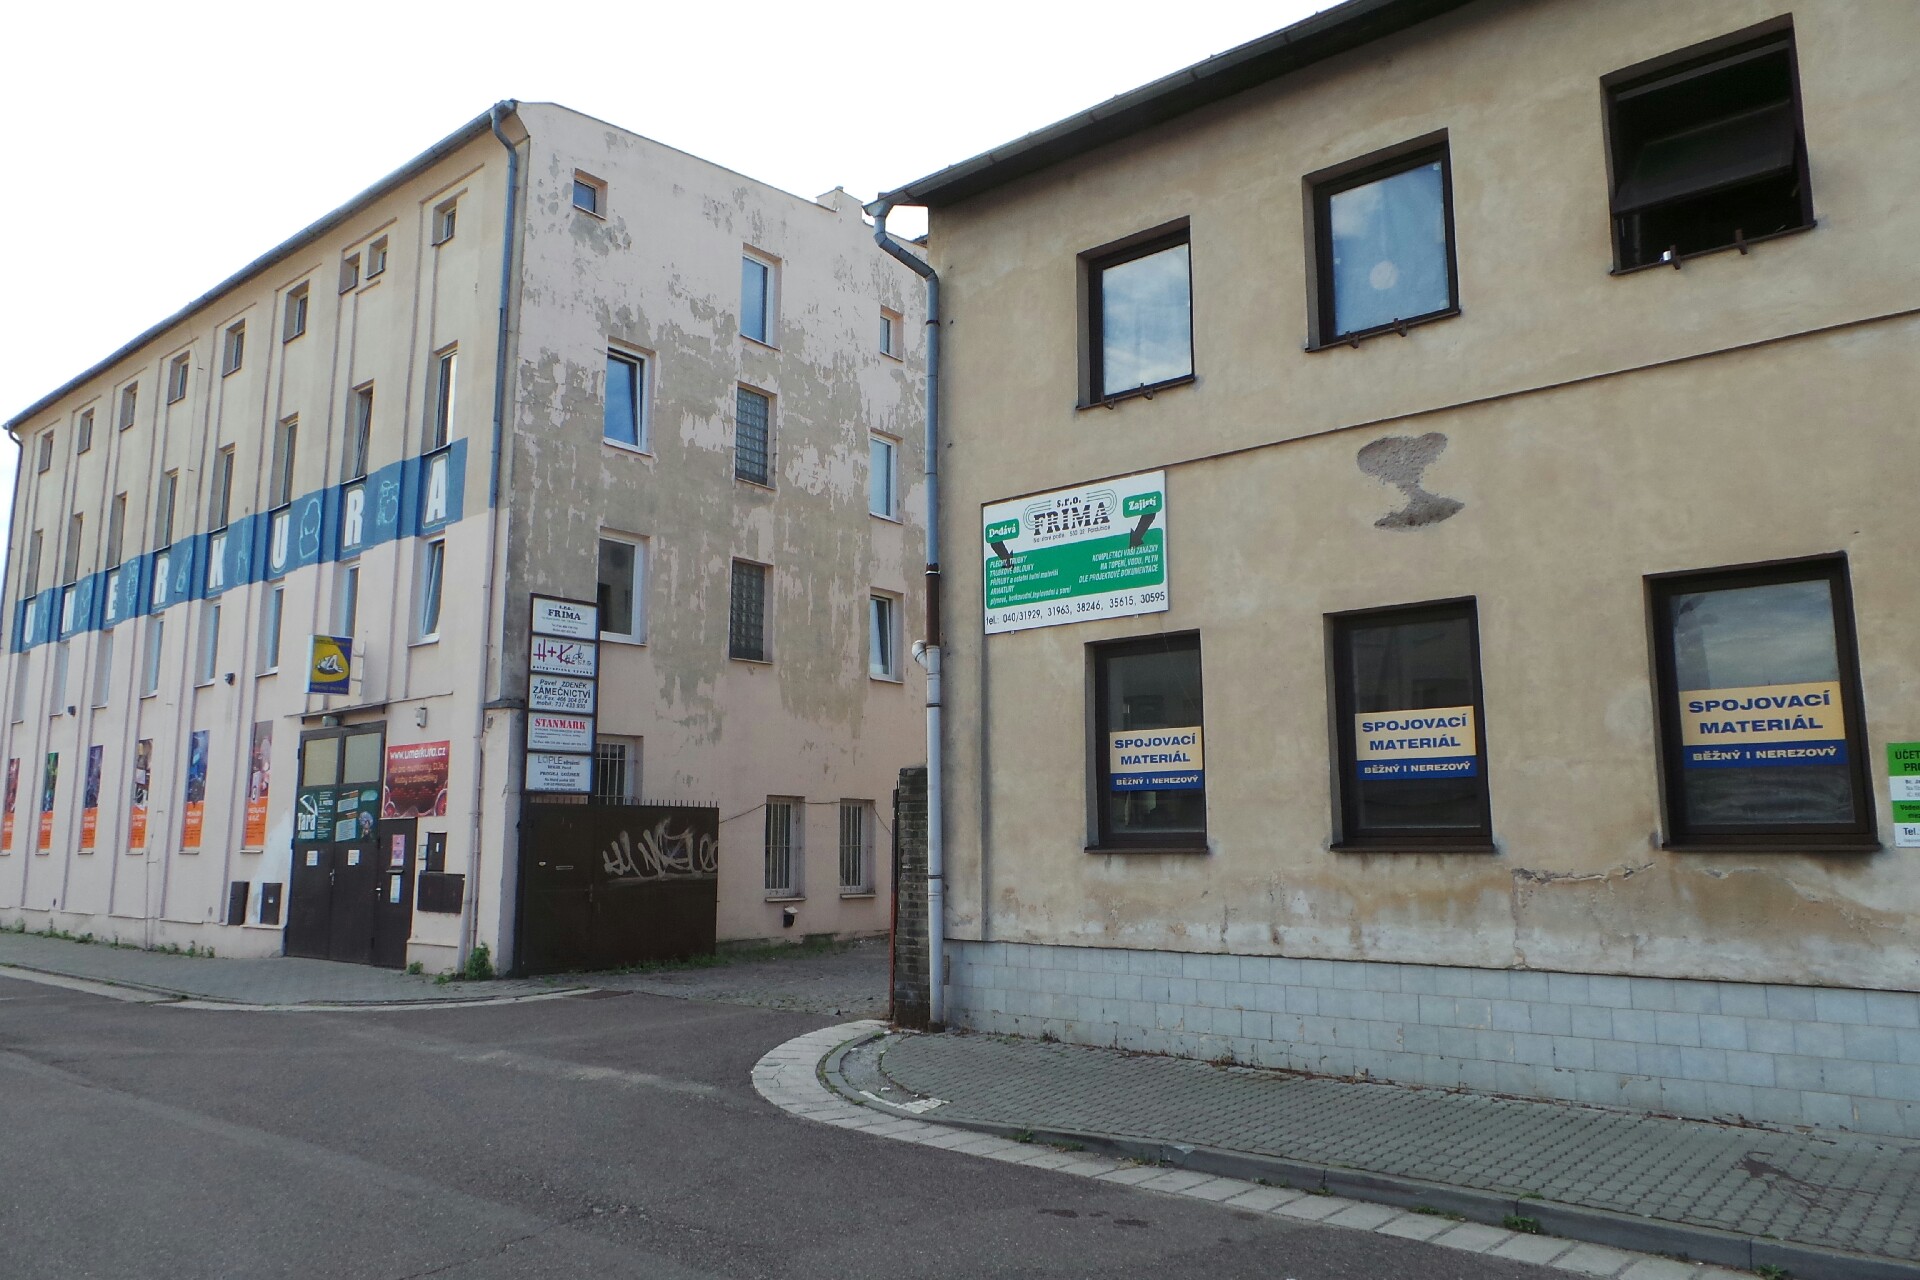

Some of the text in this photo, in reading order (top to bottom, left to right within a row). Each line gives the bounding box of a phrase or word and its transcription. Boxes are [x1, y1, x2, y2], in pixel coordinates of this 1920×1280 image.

[1057, 496, 1081, 508] s.r.o.
[1034, 502, 1110, 535] FRIMA
[989, 524, 1016, 537] Dodává
[1003, 609, 1043, 623] 040/31929,
[1048, 605, 1072, 617] 31963,
[1077, 600, 1103, 612] 38246,
[1110, 596, 1137, 608] 35615,
[1141, 591, 1165, 604] 30595
[548, 609, 581, 620] FRIMA
[533, 685, 590, 698] ZÁMEČNICTVÍ
[1689, 690, 1830, 713] SPOJOVACÍ
[535, 718, 586, 729] STANMARK
[1362, 713, 1466, 732] SPOJOVACÍ
[1700, 715, 1824, 734] MATERIÁL
[1115, 733, 1195, 748] SPOJOVACÍ
[1370, 734, 1460, 750] MATERIÁL
[1121, 751, 1190, 765] MATERIÁL
[1693, 750, 1740, 761] BĚŽNÝ
[1756, 746, 1836, 758] NEREZOVÝ
[1364, 764, 1400, 773] BĚŽNÝ
[1411, 761, 1470, 772] NEREZOVÝ
[1116, 777, 1143, 785] BĚŽNÝ
[1152, 775, 1198, 784] NEREZOVÝ
